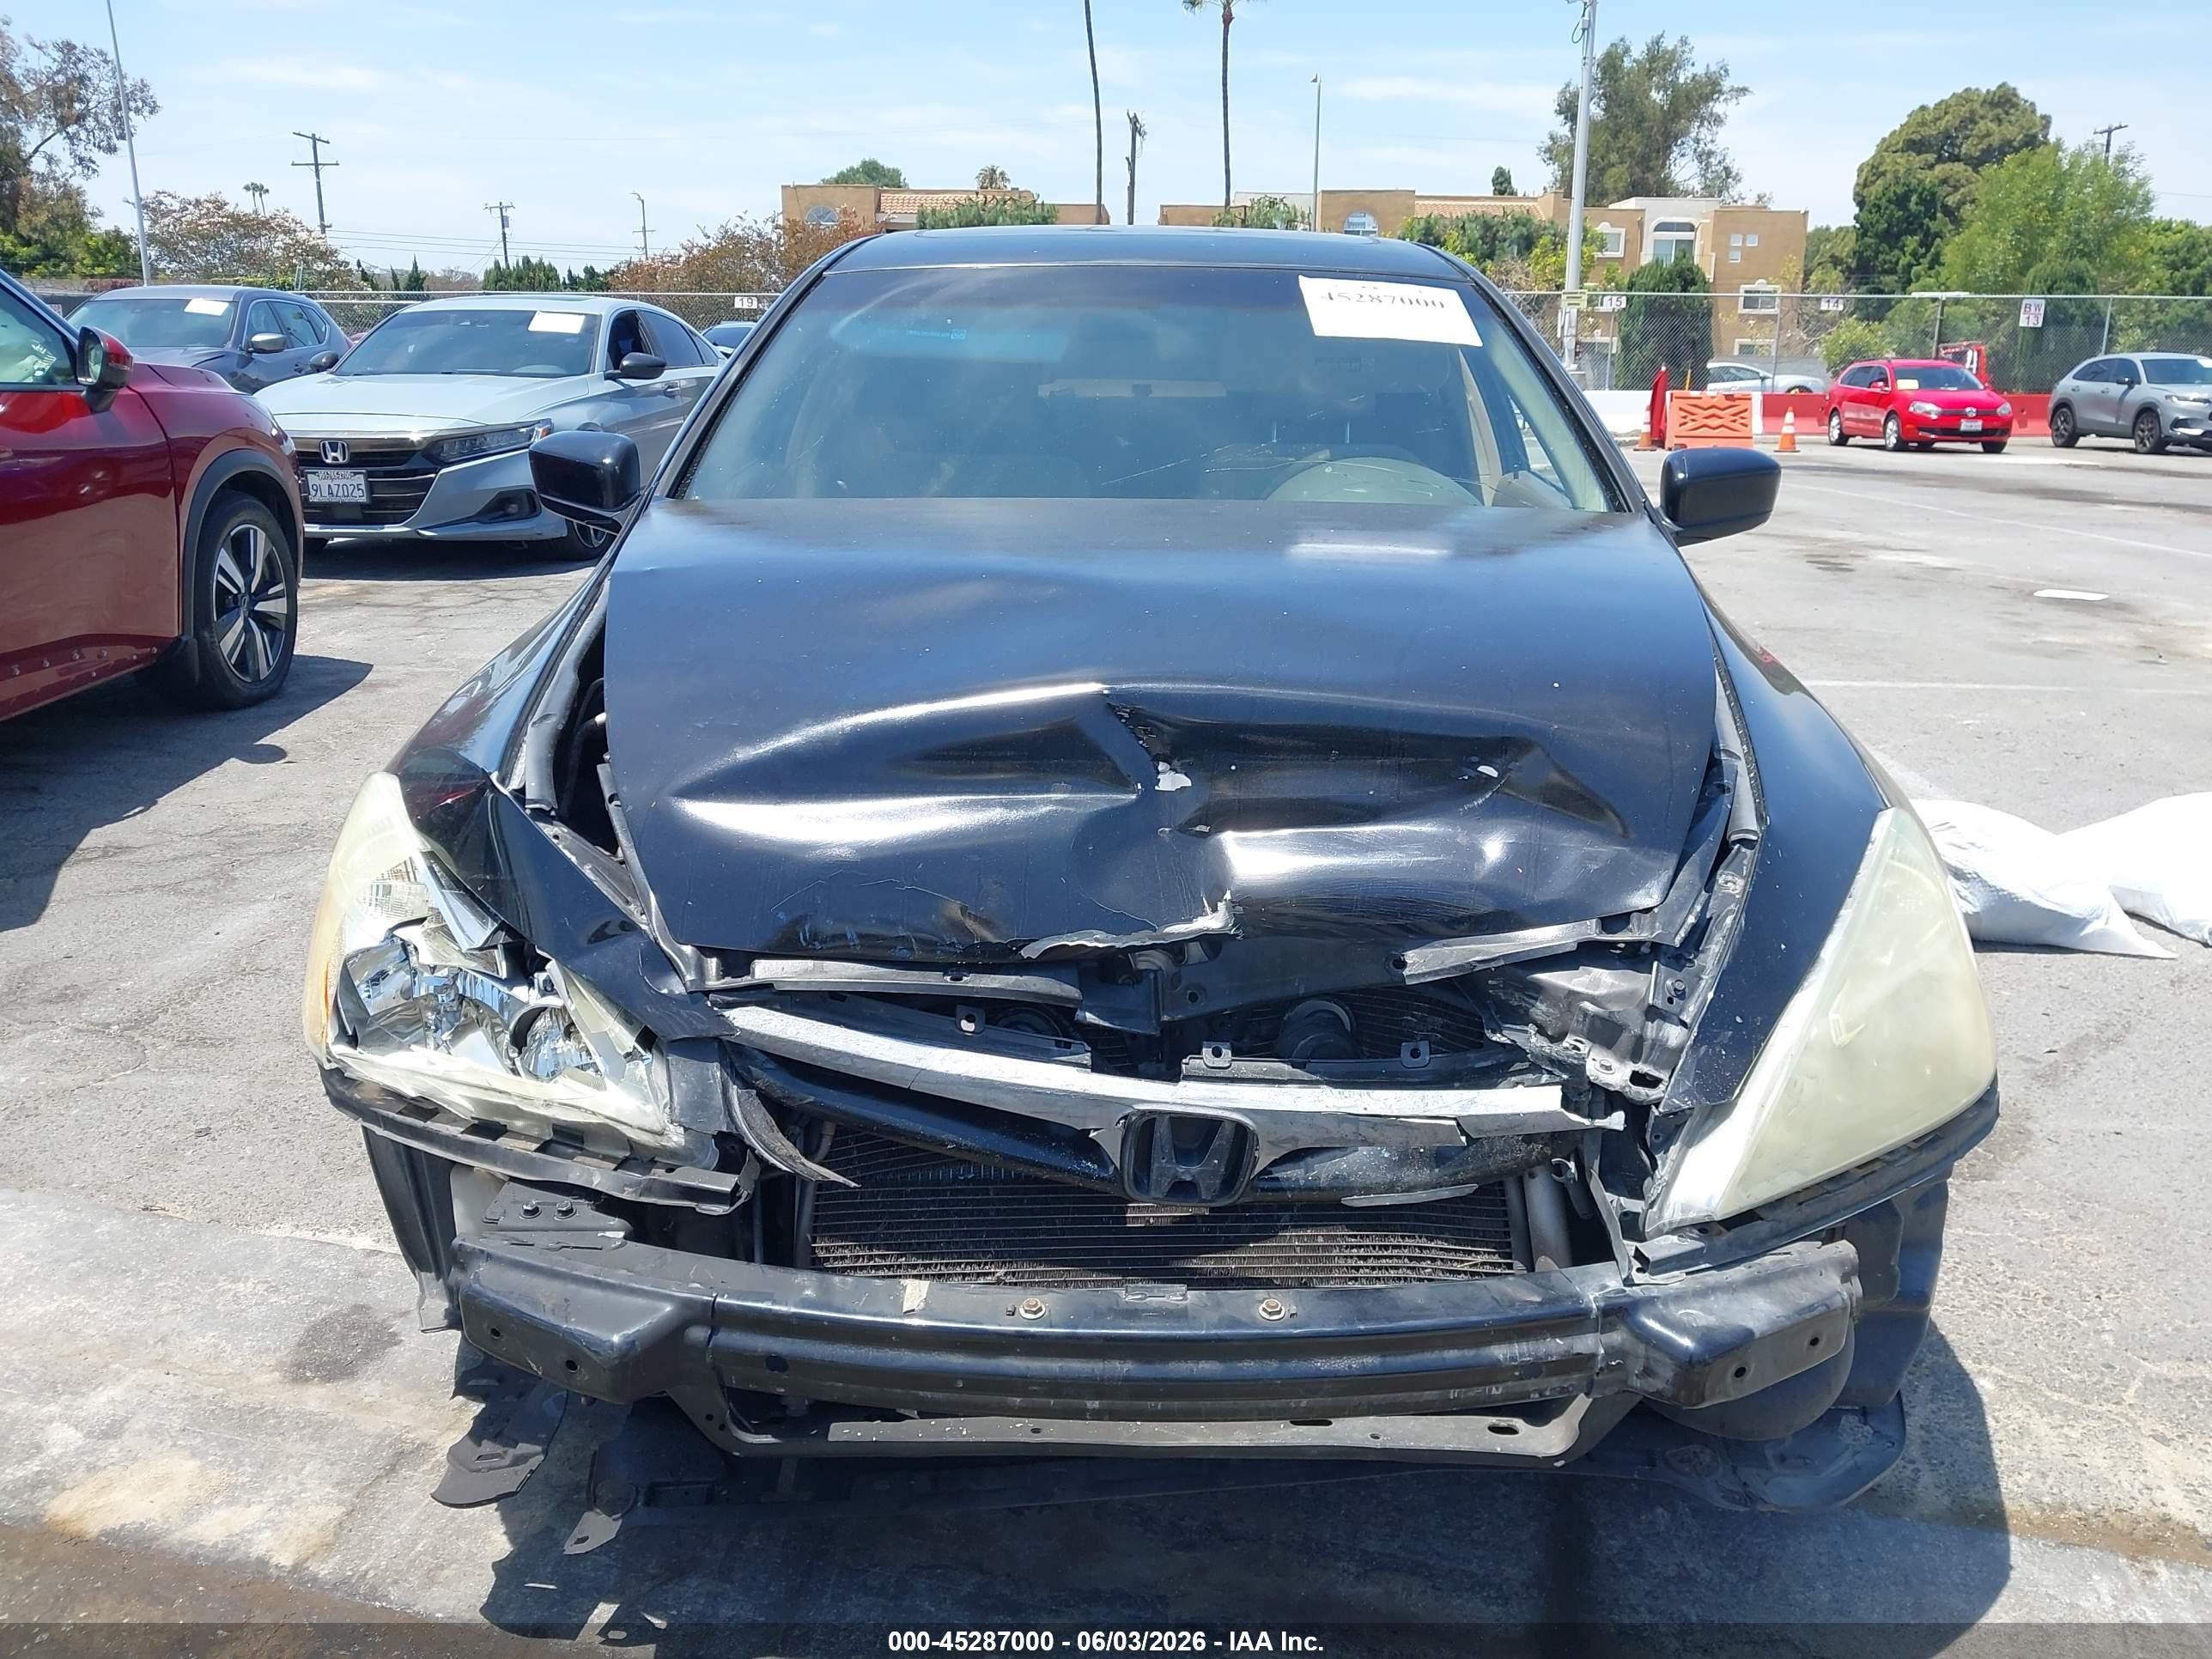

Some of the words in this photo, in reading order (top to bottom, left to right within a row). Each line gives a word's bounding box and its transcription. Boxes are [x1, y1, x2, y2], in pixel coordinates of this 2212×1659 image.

[738, 297, 754, 307] 19
[1607, 297, 1622, 307] 15
[2026, 315, 2039, 325] 13
[311, 483, 365, 498] 9LAZ025
